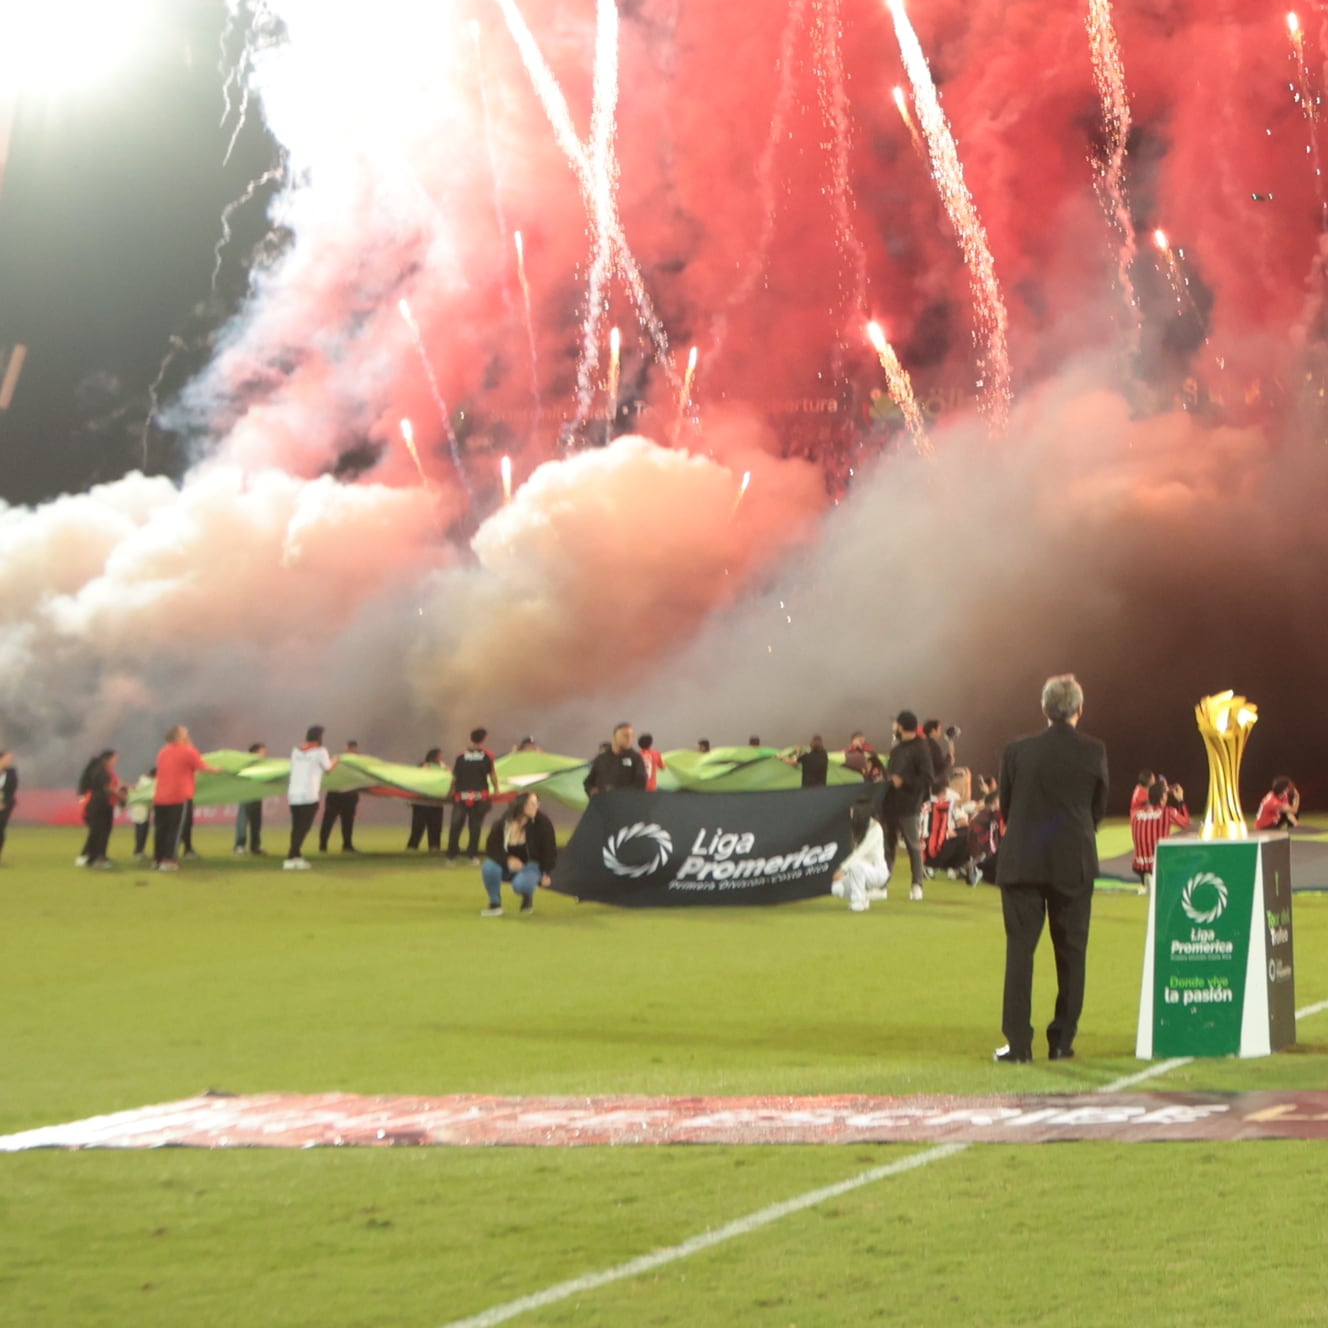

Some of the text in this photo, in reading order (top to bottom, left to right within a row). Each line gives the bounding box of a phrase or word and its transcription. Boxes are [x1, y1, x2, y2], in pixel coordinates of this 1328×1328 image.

[691, 827, 755, 861] Liga
[676, 841, 839, 881] Promerica
[1191, 927, 1215, 942] Liga
[1170, 939, 1233, 955] Promerica
[1169, 975, 1229, 988] Donde vive
[1164, 984, 1233, 1006] la pasión
